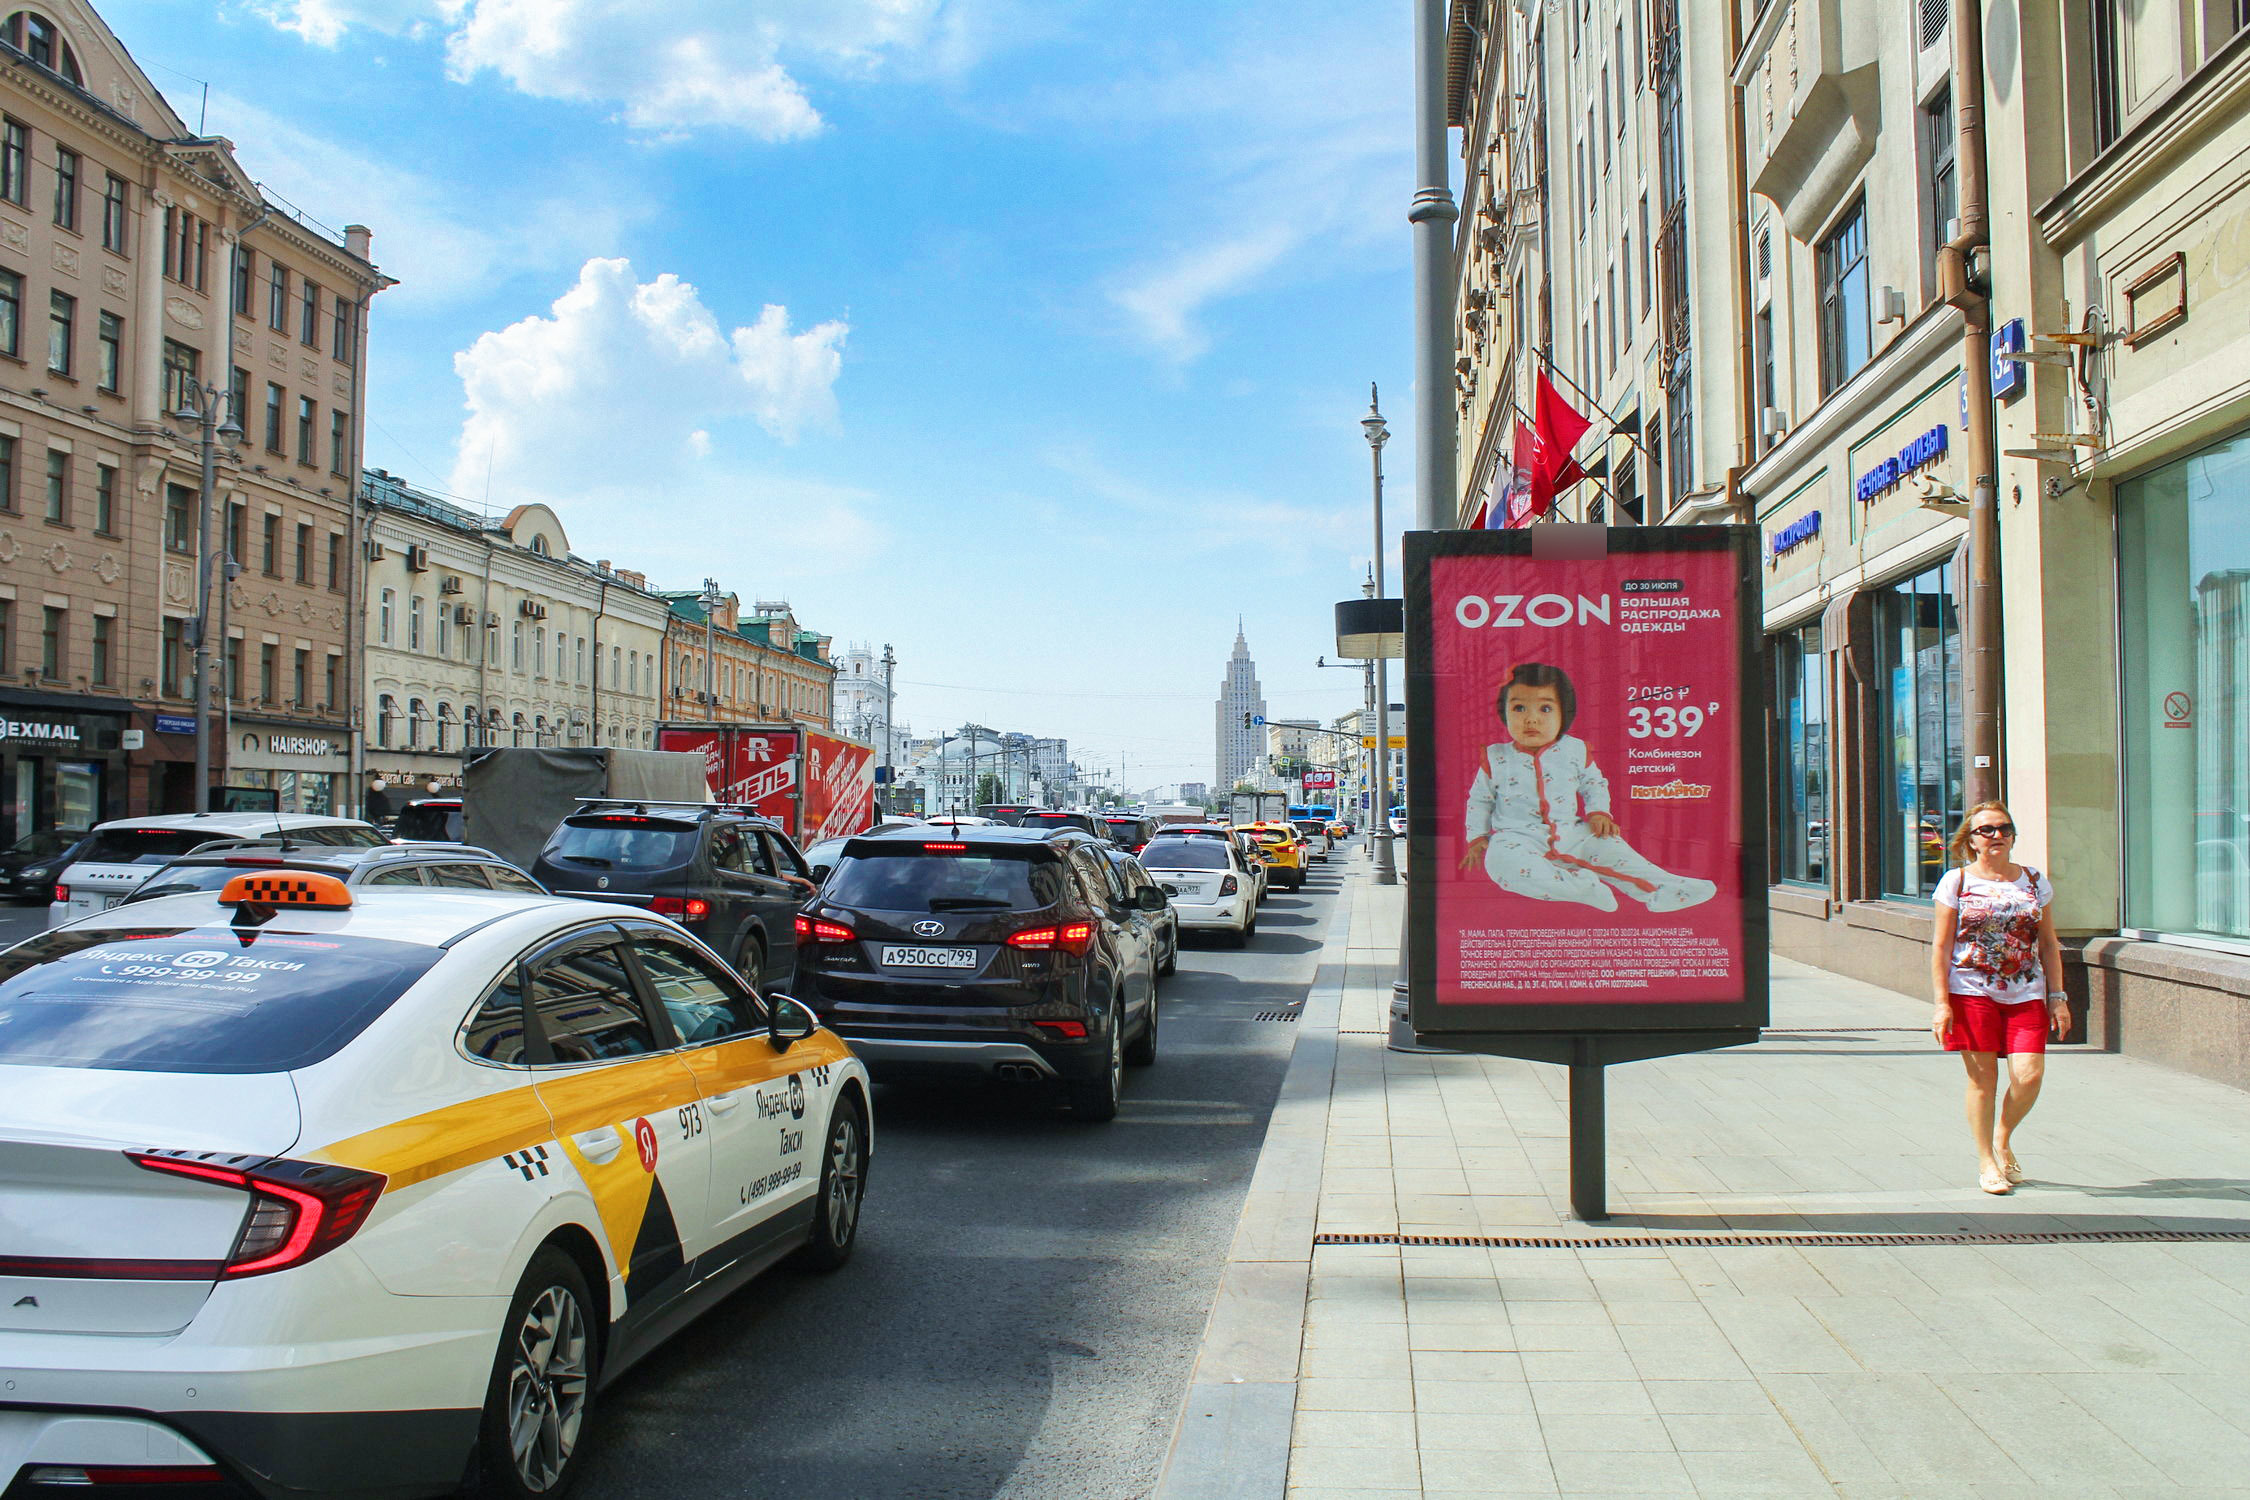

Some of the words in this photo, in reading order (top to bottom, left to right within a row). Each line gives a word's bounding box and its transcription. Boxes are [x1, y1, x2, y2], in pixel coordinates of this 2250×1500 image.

[1994, 342, 2011, 380] 32
[1857, 457, 1895, 501] РЕЧНЫЕ
[1898, 425, 1942, 474] КРУИЗЫ
[1456, 593, 1611, 628] OZON
[1620, 597, 1690, 607] БОЛЬШАЯ
[1621, 609, 1721, 620] РАСПРОДАЖА
[1621, 622, 1685, 633] ОДЕЖДЫ
[8, 721, 80, 740] EXMAIL
[1628, 706, 1704, 738] 339
[271, 735, 328, 755] HAIRSHOP
[1628, 748, 1702, 759] Комбинезон
[1628, 763, 1676, 774] детский
[1631, 779, 1711, 799] КОТМАРКОТ
[1507, 929, 1528, 938] ПЕРИОД
[1530, 929, 1565, 938] ПРОВЕДЕНИЯ
[1643, 929, 1677, 938] АКЦИОННАЯ
[1461, 939, 1505, 948] ДЕЙСТВИТЕЛЬНА
[1593, 939, 1632, 948] ПРОМЕЖУТОК
[1638, 938, 1660, 947] ПЕРИОД
[1662, 938, 1697, 947] ПРОВЕДЕНИЯ
[78, 950, 174, 963] Яндекс
[226, 955, 307, 972] Такси
[886, 949, 946, 964] А950СС
[949, 949, 972, 962] 799
[1461, 949, 1483, 958] ТОЧНОЕ
[1503, 949, 1531, 958] ДЕЙСТВИЯ
[1532, 949, 1562, 958] ЦЕНОВОГО
[1606, 949, 1632, 958] УКАЗАНО
[1670, 948, 1706, 957] КОЛИЧЕСТВО
[1708, 948, 1728, 957] ТОВАРА
[1500, 960, 1539, 968] ИНФОРМАЦИЯ
[1550, 959, 1590, 968] ОРГАНИЗАТОРЕ
[1682, 959, 1705, 967] СРОКАХ
[118, 965, 262, 983] 999-99-99
[1461, 970, 1496, 979] ПРОВЕДЕНИЯ
[1498, 970, 1528, 979] ДОСТУПНА
[200, 983, 236, 991] Google
[1461, 980, 1501, 989] ПРЕСНЕНСКАЯ
[756, 1088, 790, 1120] Яндекс
[790, 1081, 803, 1111] Go
[679, 1103, 702, 1140] 973
[640, 1126, 654, 1164] Я
[779, 1127, 803, 1157] Такси
[747, 1175, 768, 1204] (495)
[768, 1161, 802, 1191] 999-99-99
